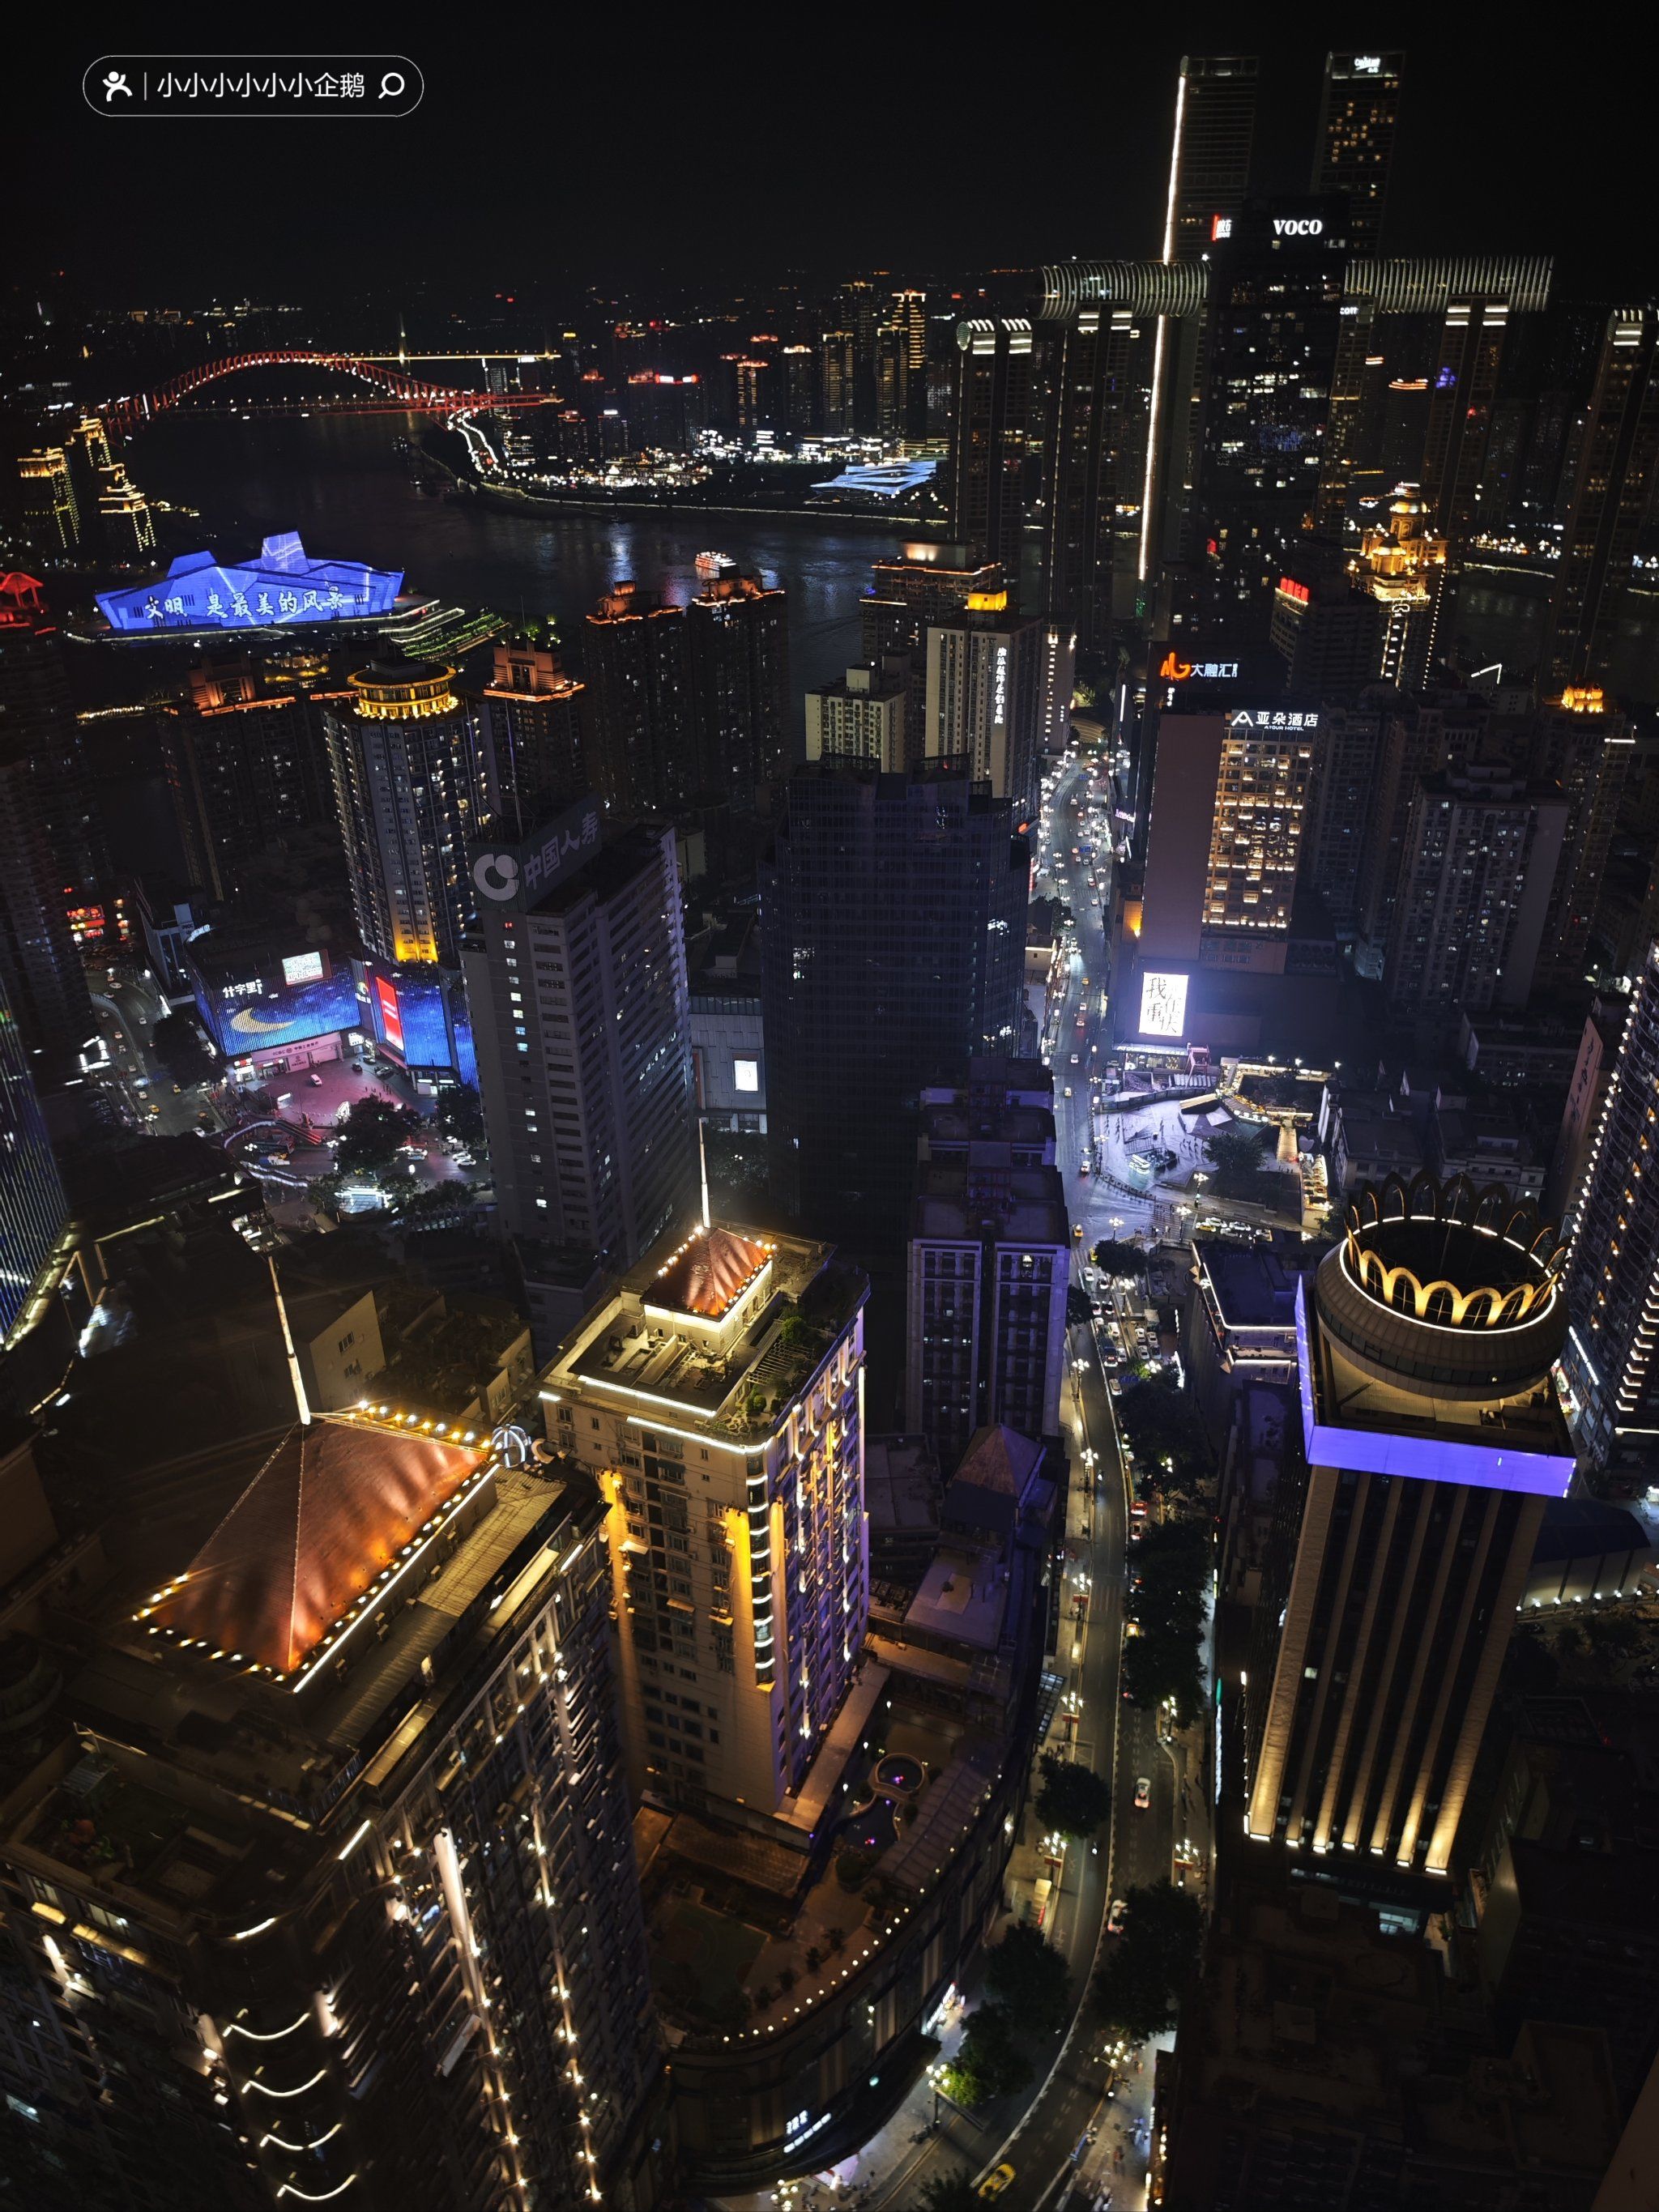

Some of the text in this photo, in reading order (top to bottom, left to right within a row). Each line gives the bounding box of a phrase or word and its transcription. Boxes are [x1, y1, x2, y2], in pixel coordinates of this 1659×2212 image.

[207, 585, 345, 620] 是最美的风景
[1256, 711, 1319, 727] 亚朵酒店
[523, 811, 599, 890] 中国人寿
